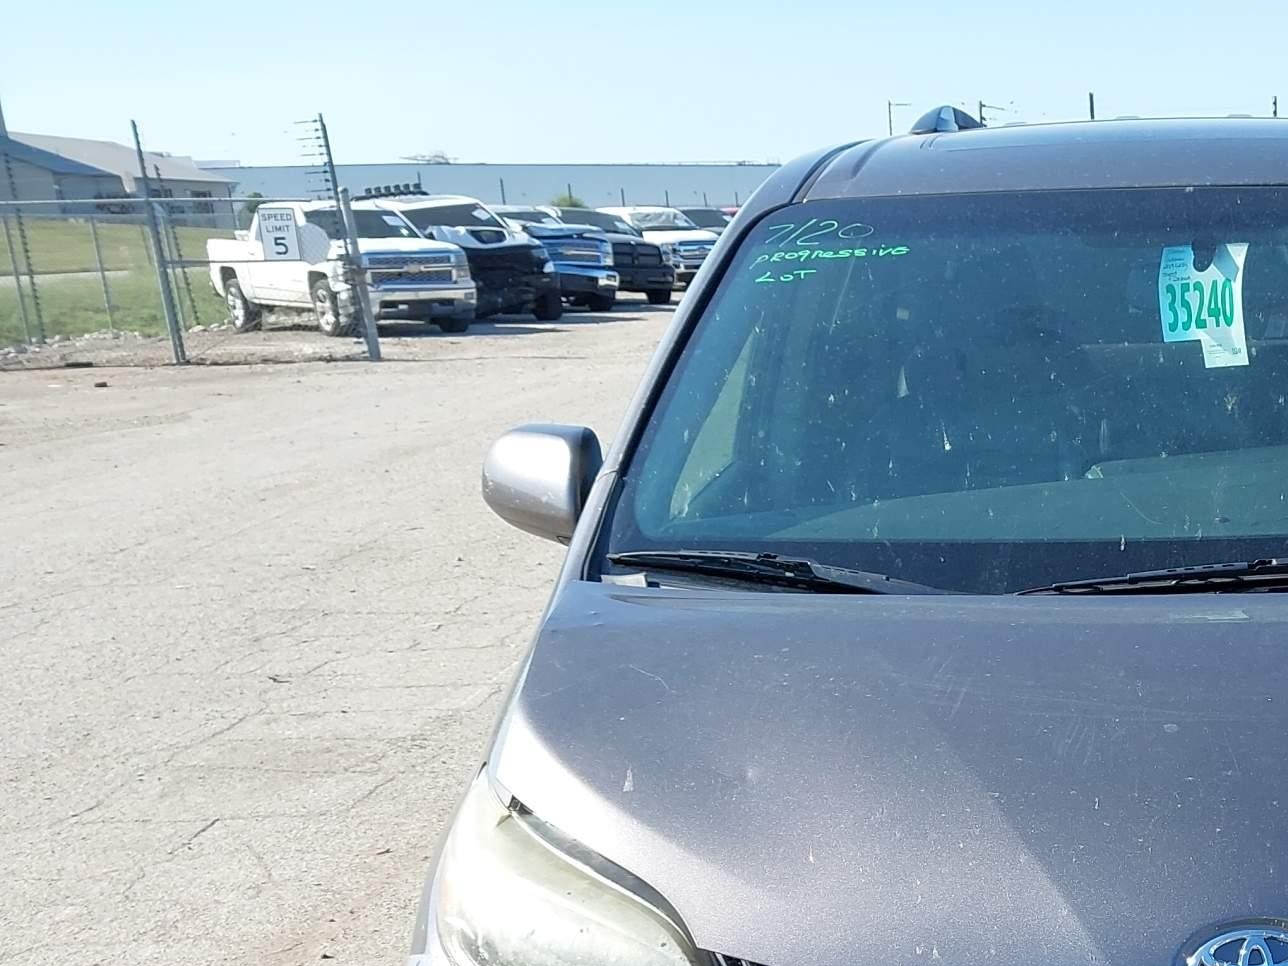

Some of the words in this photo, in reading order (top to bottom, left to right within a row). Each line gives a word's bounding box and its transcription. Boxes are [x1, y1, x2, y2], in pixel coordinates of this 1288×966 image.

[261, 213, 292, 222] SPEED
[266, 225, 290, 233] LIMIT
[764, 218, 875, 248] 7/20
[273, 237, 289, 255] 5
[1165, 278, 1234, 333] 35240
